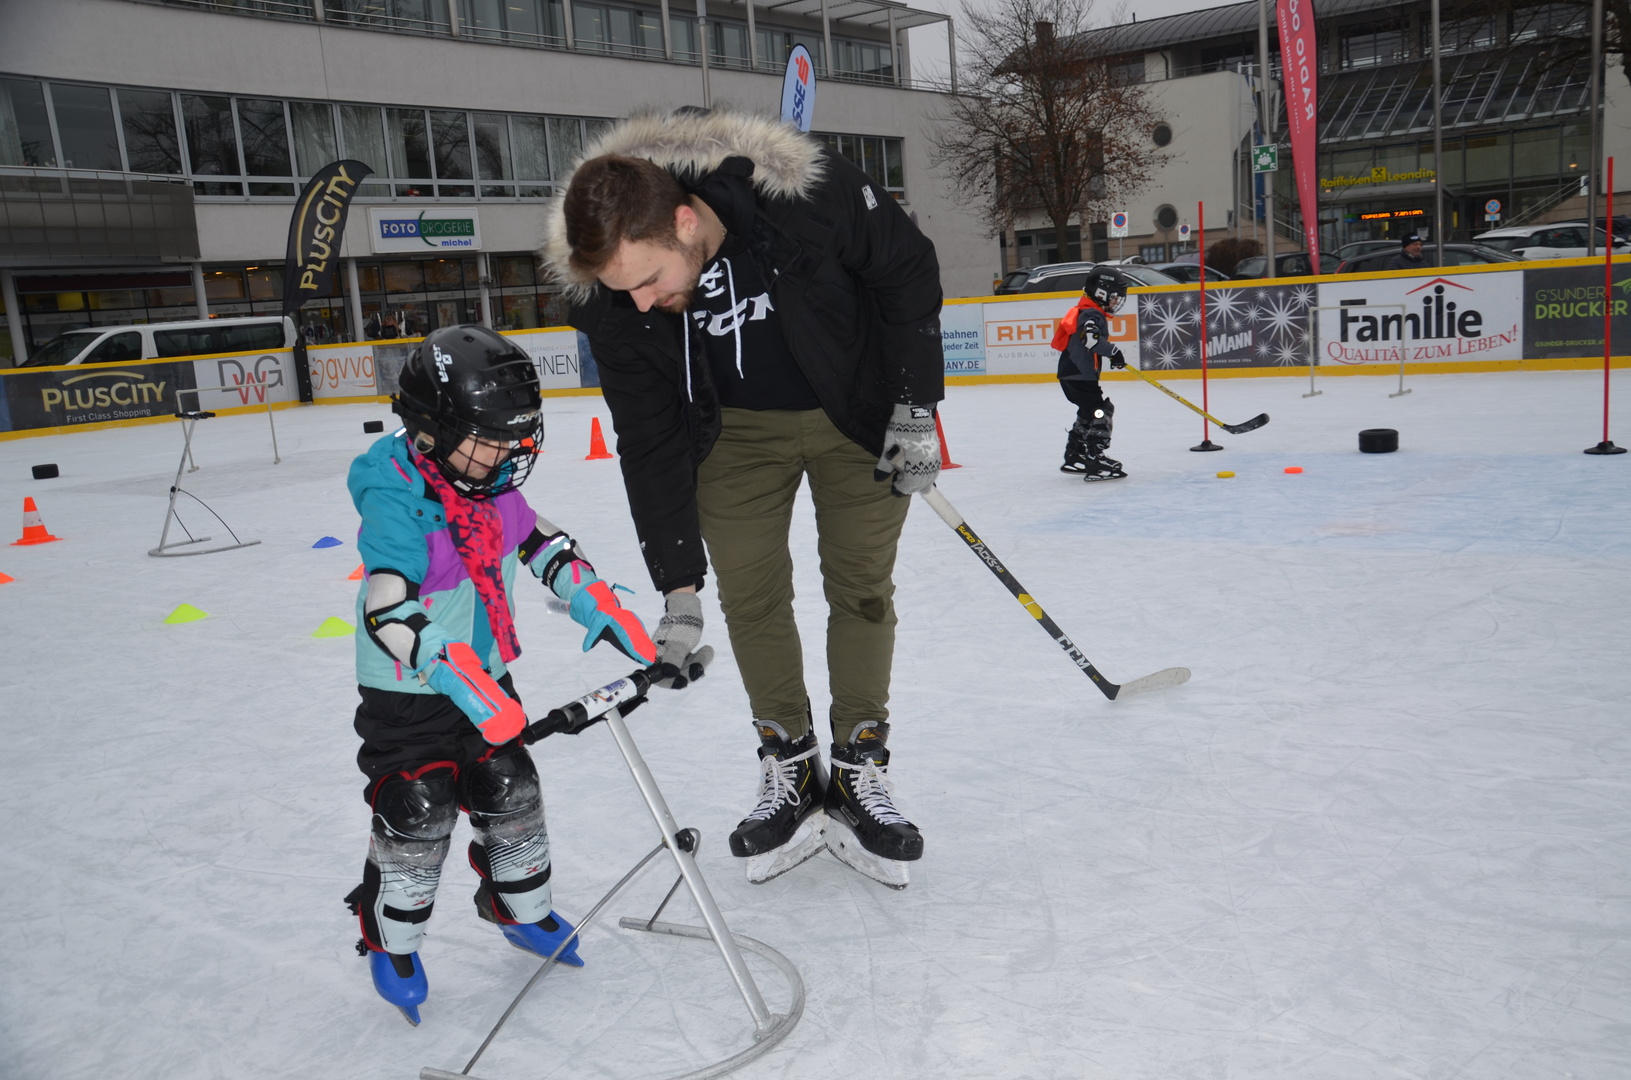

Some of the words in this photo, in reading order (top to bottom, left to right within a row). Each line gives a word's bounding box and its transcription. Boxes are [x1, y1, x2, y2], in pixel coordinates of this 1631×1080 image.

[1320, 175, 1371, 188] Raiffeisen
[299, 164, 355, 291] PLUSCITY
[382, 223, 417, 235] FOTO
[421, 221, 471, 234] DROGERIE
[441, 238, 472, 247] michel
[1535, 285, 1607, 302] G'SUNDER
[1340, 285, 1483, 343] Familie
[1535, 300, 1629, 320] DRUCKER
[997, 323, 1052, 341] RHT
[943, 343, 962, 351] jeder
[964, 342, 979, 350] Zeit
[997, 351, 1036, 359] AUSBAU
[1414, 344, 1452, 359] ZUM
[432, 344, 450, 383] JOFA
[944, 360, 980, 370] ANY.DE
[41, 381, 167, 413] PLUSCITY
[66, 414, 88, 423] First
[88, 411, 112, 421] Class
[113, 408, 151, 419] Shopping
[957, 525, 976, 544] SUPER
[1056, 633, 1091, 670] CCM
